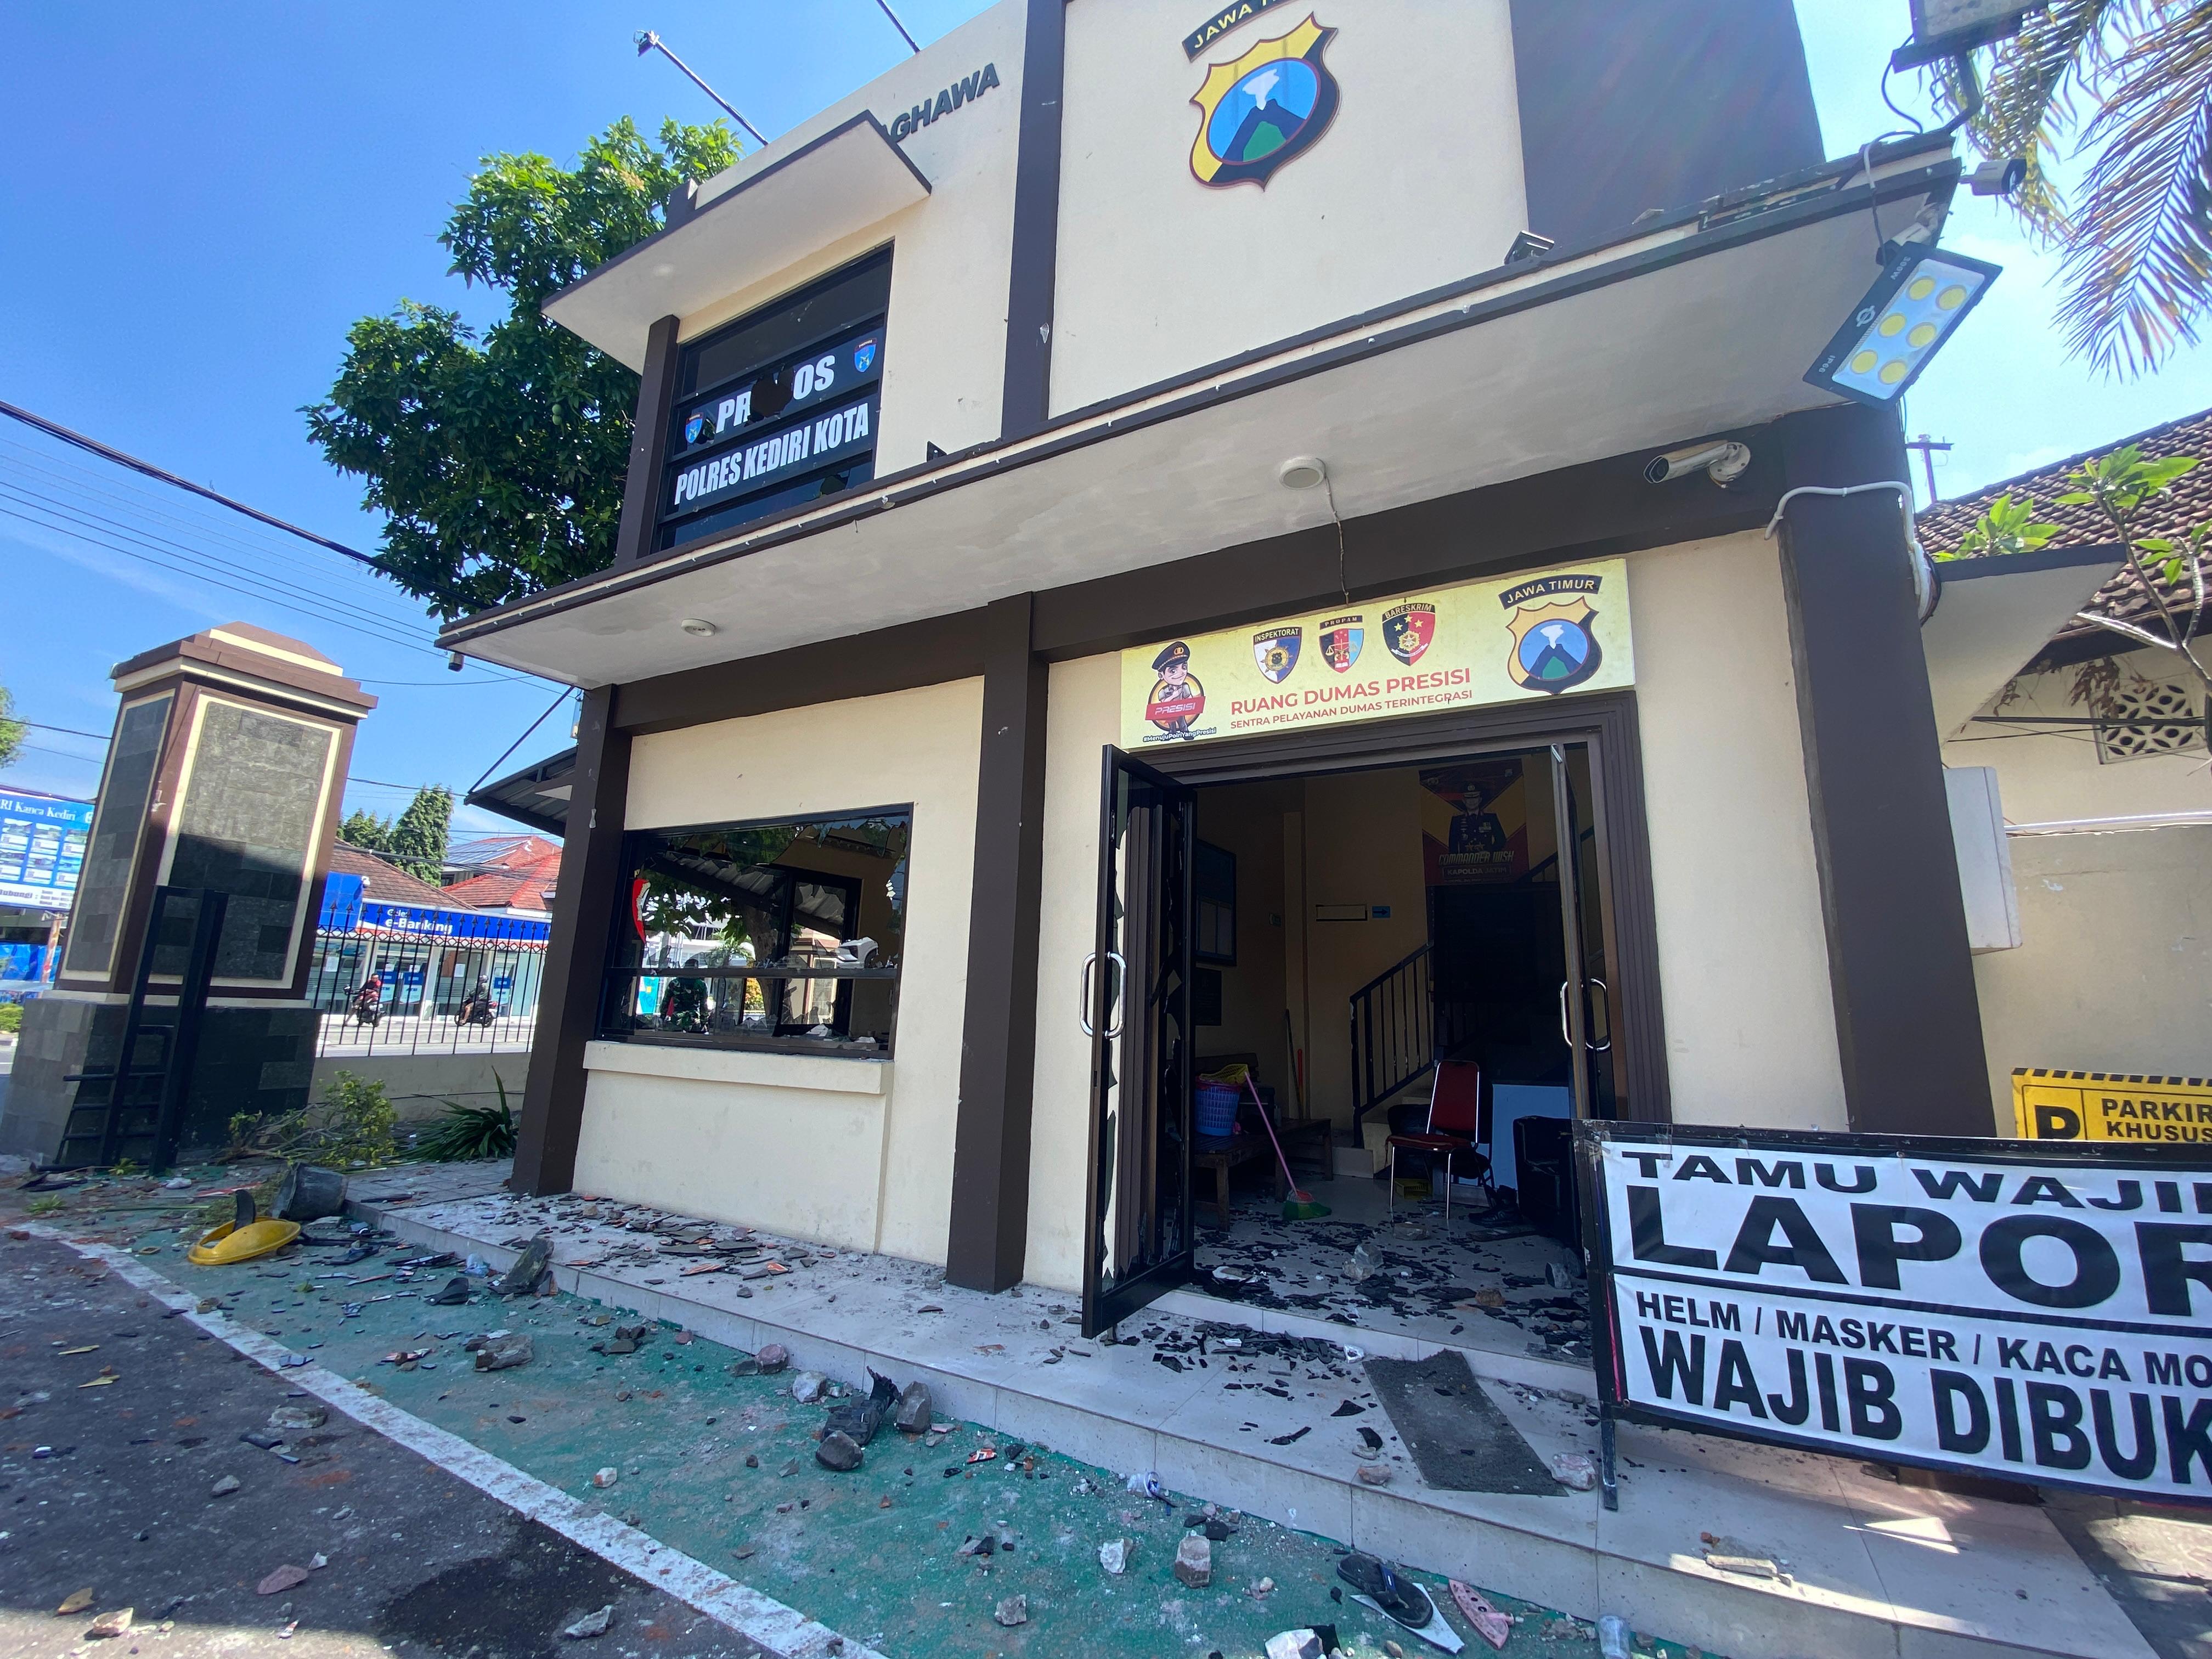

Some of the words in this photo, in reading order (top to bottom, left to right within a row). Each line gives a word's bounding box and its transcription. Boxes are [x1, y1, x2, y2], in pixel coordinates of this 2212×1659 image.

[1194, 3, 1252, 48] JAWA
[883, 62, 1000, 143] GHAWA
[1819, 355, 1836, 373] IP66
[715, 355, 836, 433] PROS
[674, 452, 742, 505] POLRES
[743, 425, 810, 481] KEDIRI
[814, 403, 868, 454] KOTA
[1507, 584, 1545, 603] JAWA
[1549, 579, 1594, 590] TIMUR
[1325, 616, 1357, 627] PROPAM
[1385, 603, 1432, 619] BARESKRIM
[1255, 628, 1299, 642] INSPEKTORAT
[1231, 693, 1298, 715] RUANG
[1304, 681, 1380, 704] DUMAS
[1386, 668, 1470, 693] PRESISI
[1155, 702, 1196, 715] PRESISI
[1231, 716, 1269, 729] SENTRA
[1273, 708, 1337, 724] PELAYANAN
[1340, 702, 1382, 715] DUMAS
[1385, 690, 1472, 709] TERINTEGRASI
[1143, 727, 1217, 742] #MenujuPolriYangPresisi
[0, 799, 13, 810] RI
[385, 918, 453, 934] e-Banking
[2101, 1098, 2212, 1123] PARKIR
[2106, 1121, 2212, 1143] KHUSUS
[1622, 1151, 1877, 1193] TAMU
[1636, 1291, 1741, 1332] HELM
[1776, 1310, 1959, 1362] MASKER
[1998, 1337, 2131, 1382] KACA
[1639, 1325, 1903, 1442] WAJIB
[1929, 1368, 2212, 1485] DIBUK
